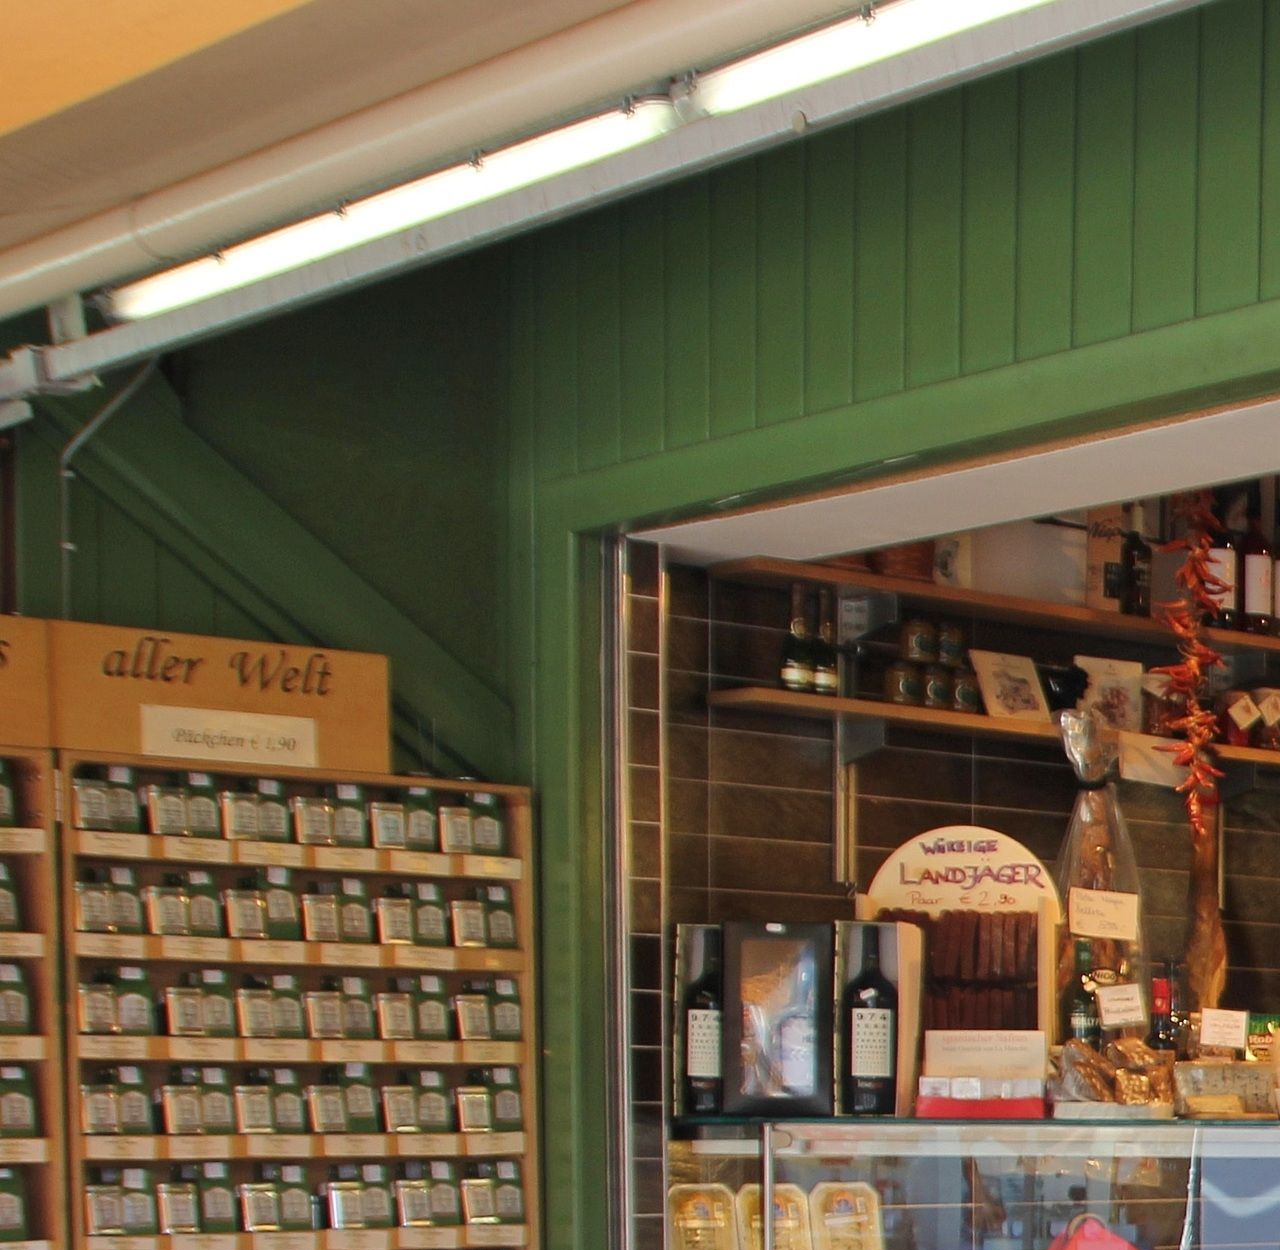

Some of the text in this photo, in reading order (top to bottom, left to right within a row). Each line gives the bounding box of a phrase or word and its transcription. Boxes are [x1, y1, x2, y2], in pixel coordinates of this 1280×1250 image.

[103, 637, 332, 695] aller Welt
[900, 858, 1045, 890] LANDJÄGER
